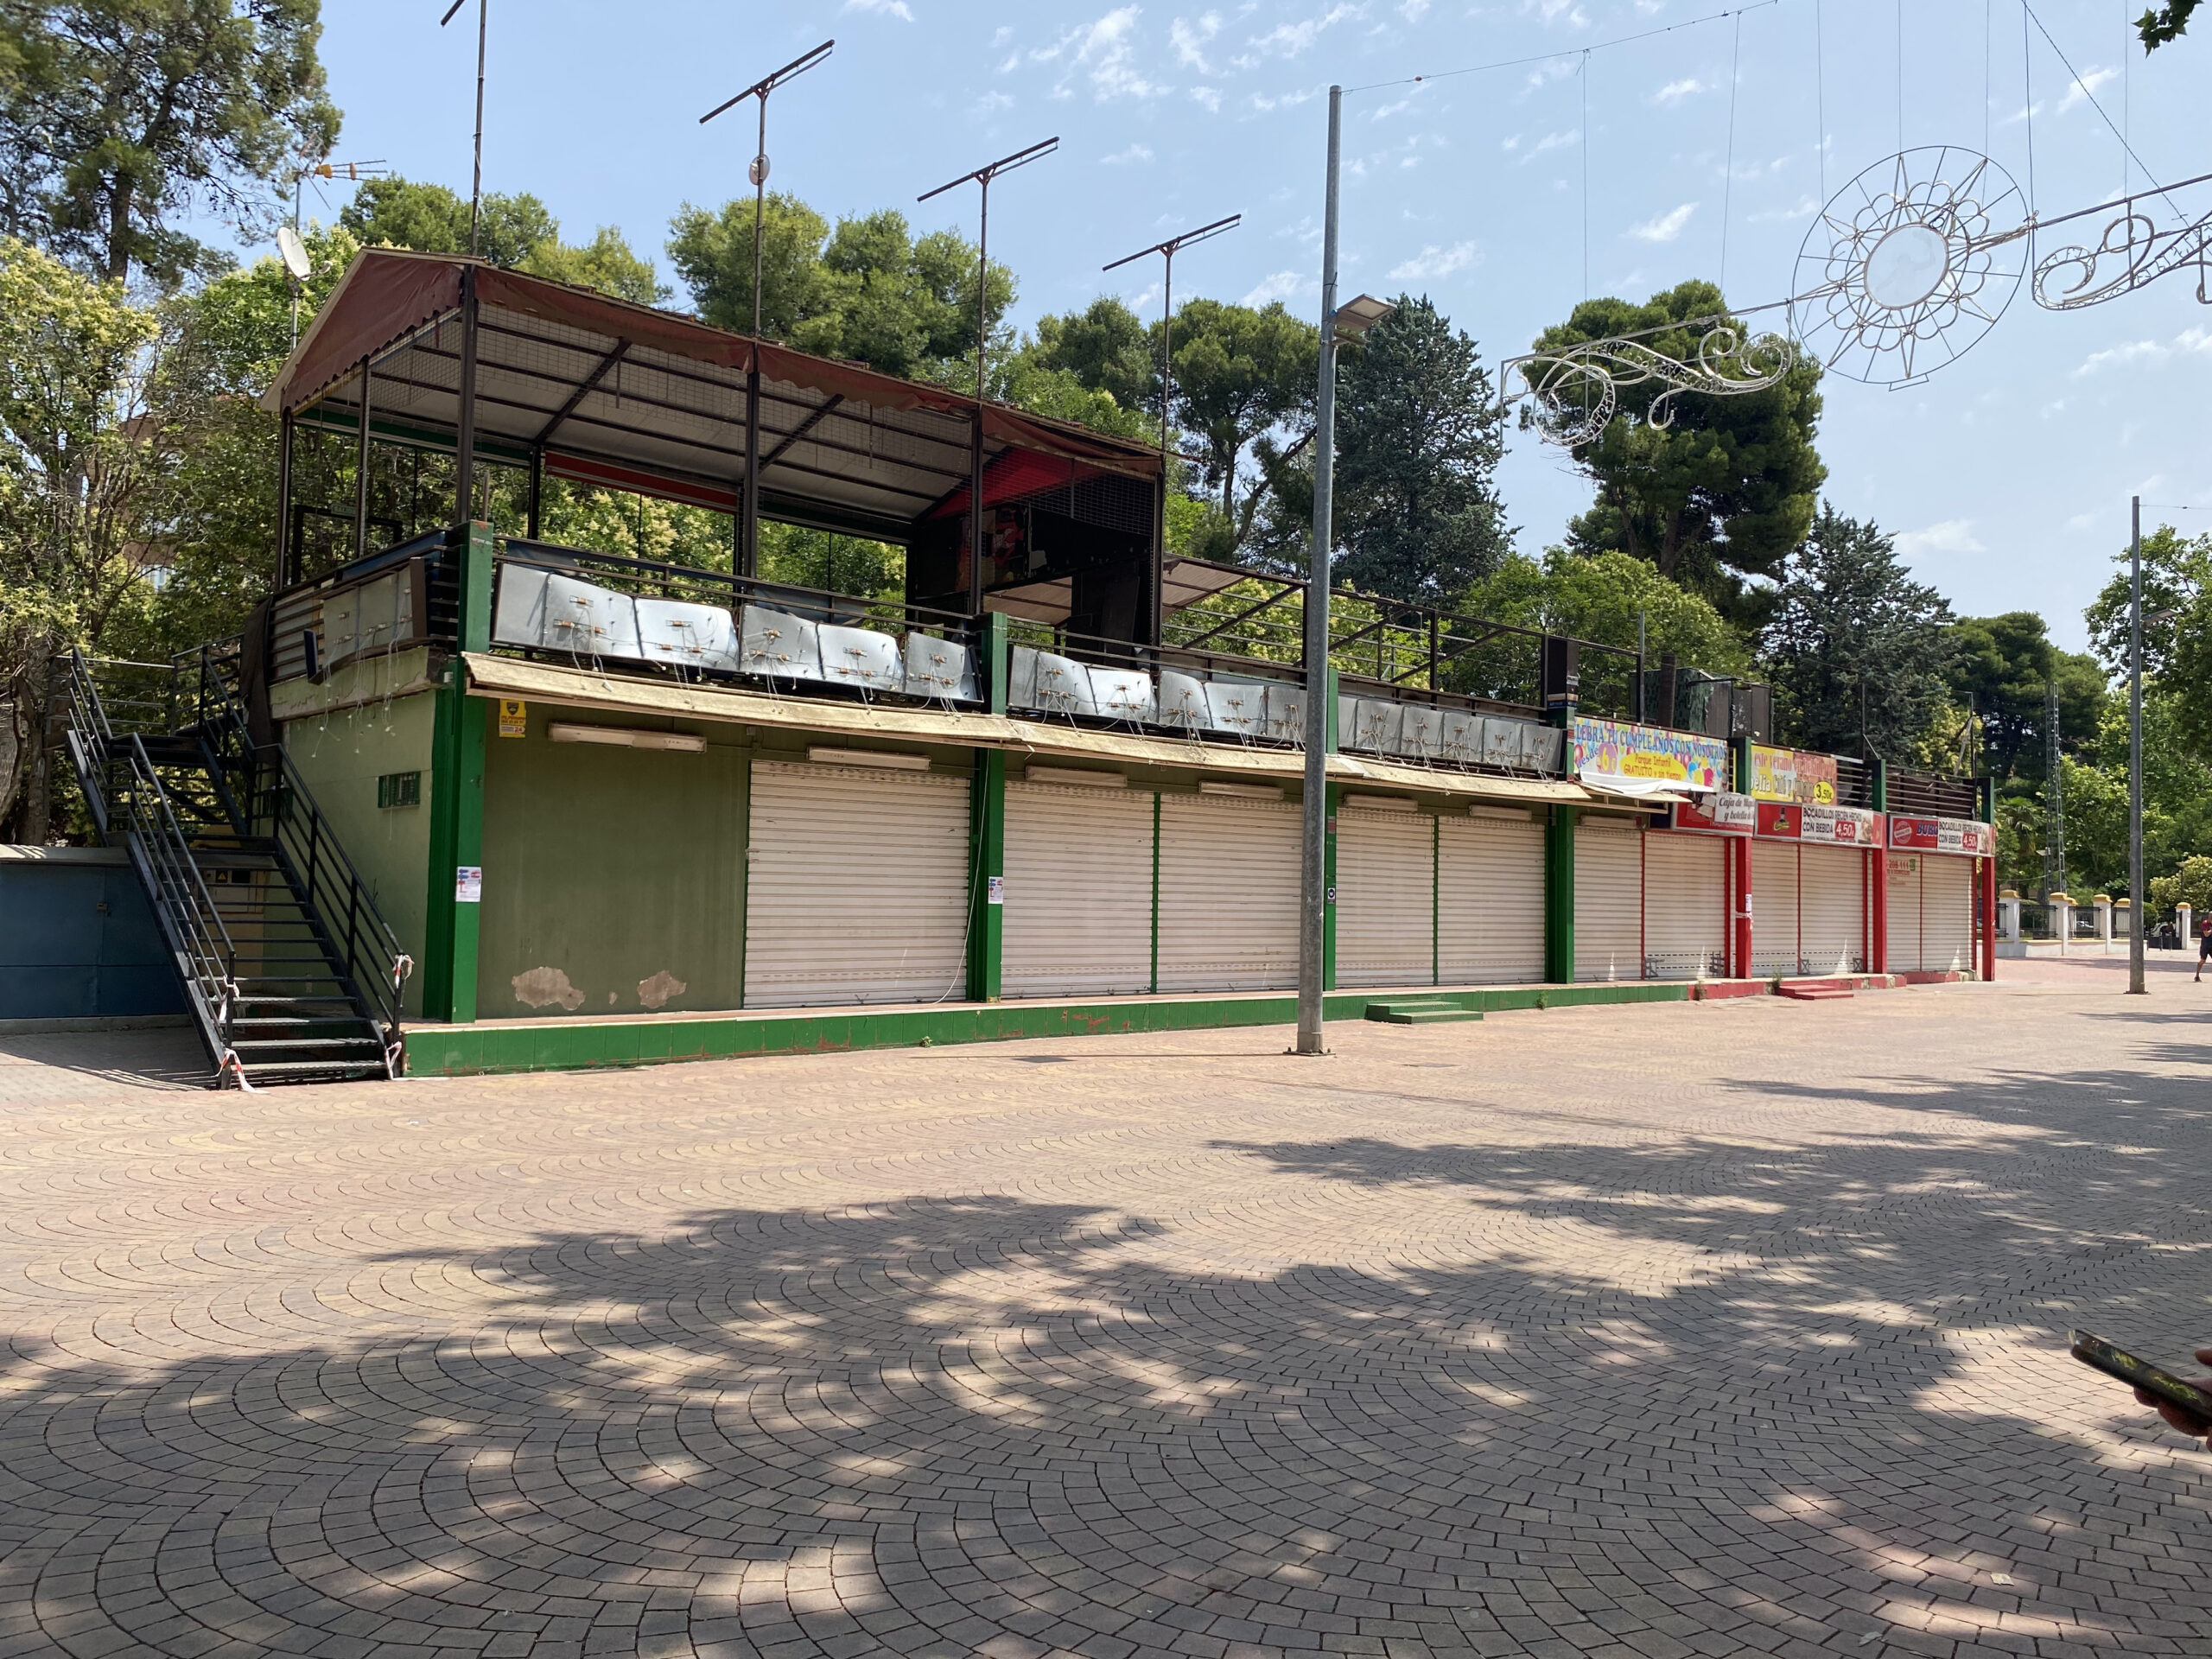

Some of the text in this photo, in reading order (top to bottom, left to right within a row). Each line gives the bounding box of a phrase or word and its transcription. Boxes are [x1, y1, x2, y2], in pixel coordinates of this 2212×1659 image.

[1576, 724, 1727, 760] LEBRA TU CUMPLEAÑOS CON NOSOTROS
[1577, 747, 1599, 769] desde
[1635, 753, 1671, 767] Parque Infantil
[1770, 754, 1792, 772] verano
[1624, 763, 1652, 777] GRATUITO
[1815, 784, 1833, 801] 3,50€
[1719, 797, 1735, 809] Caja
[1735, 798, 1742, 807] de
[1724, 811, 1729, 822] y
[1802, 807, 1834, 820] BOCADILLOS
[1802, 822, 1815, 832] CON
[1815, 822, 1834, 834] BEBIDA
[1938, 821, 1962, 831] BOCADILLOS
[1938, 834, 1948, 843] CON
